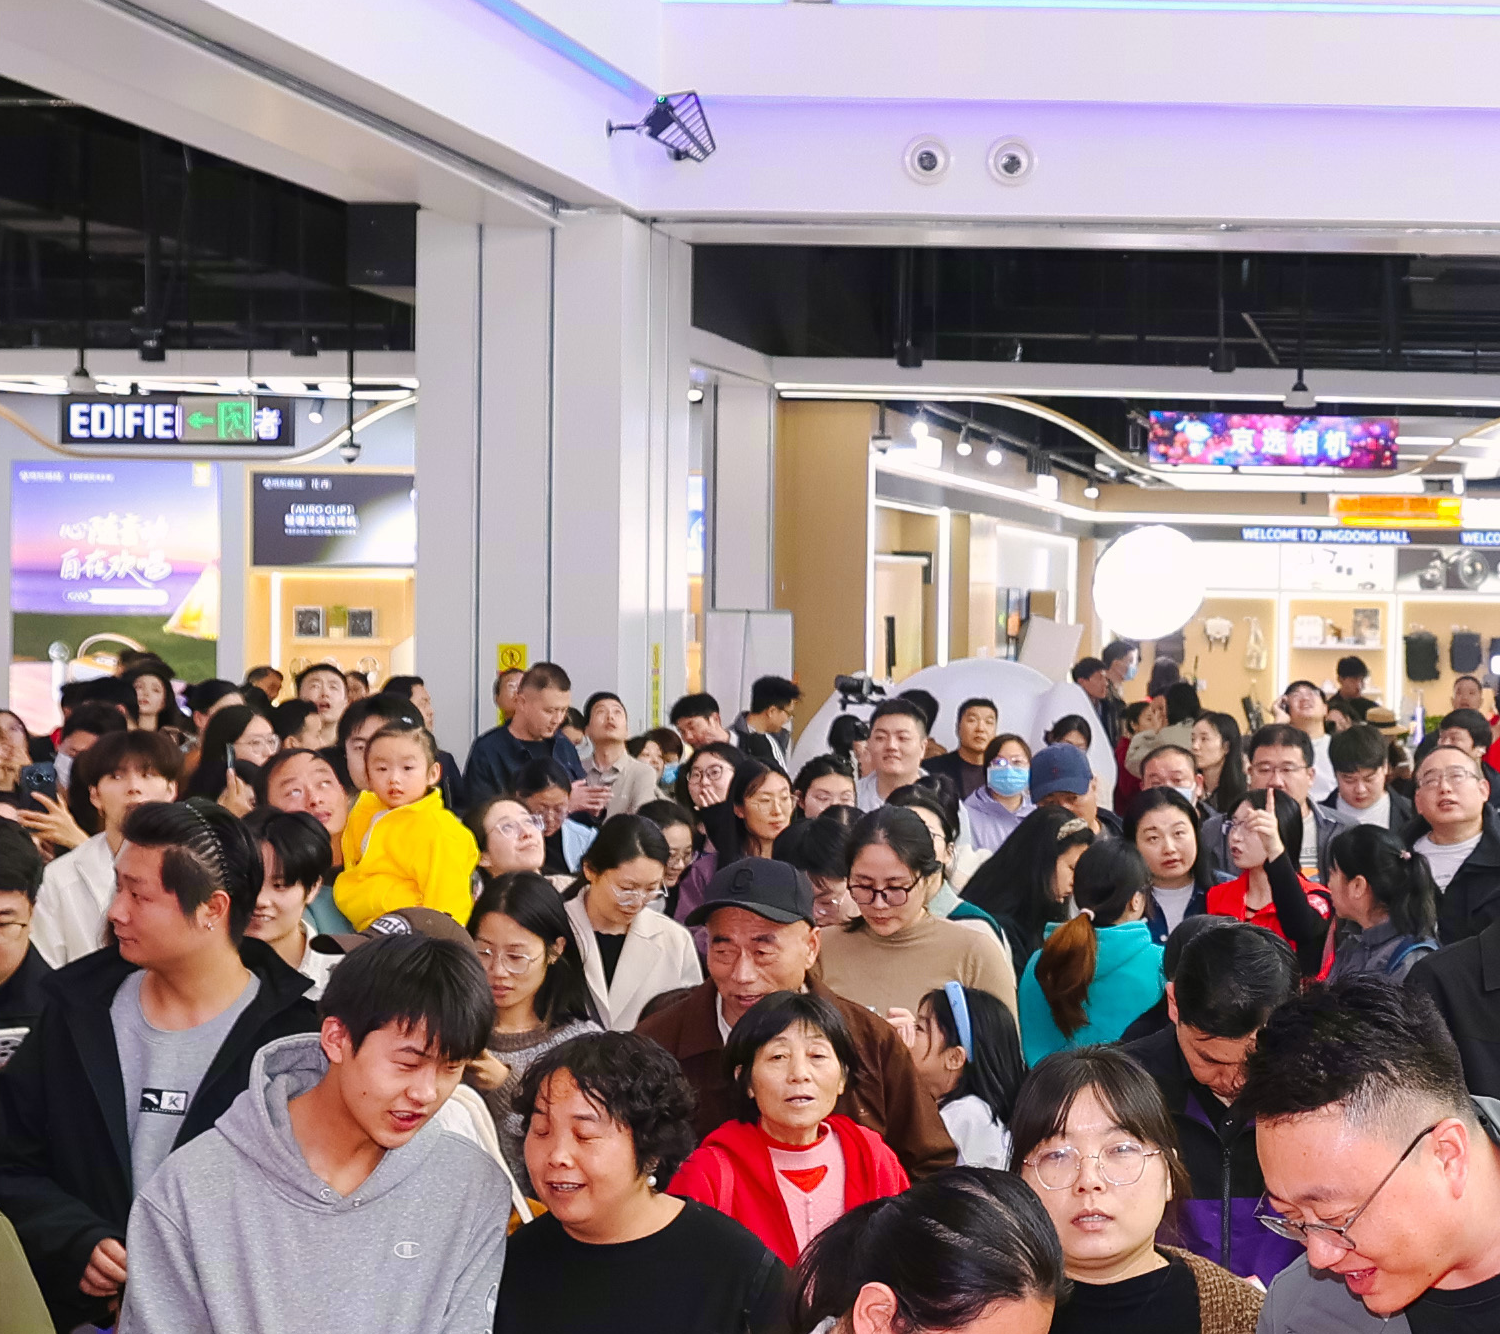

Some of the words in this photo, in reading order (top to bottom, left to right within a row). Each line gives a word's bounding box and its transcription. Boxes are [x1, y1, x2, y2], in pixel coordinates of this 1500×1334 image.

[68, 402, 183, 439] EDIFIE
[1230, 428, 1351, 458] 京选相机
[1242, 528, 1299, 542] WELCOME
[1301, 529, 1317, 542] TO
[1320, 529, 1377, 544] JINGDONG
[1379, 530, 1411, 544] MALL
